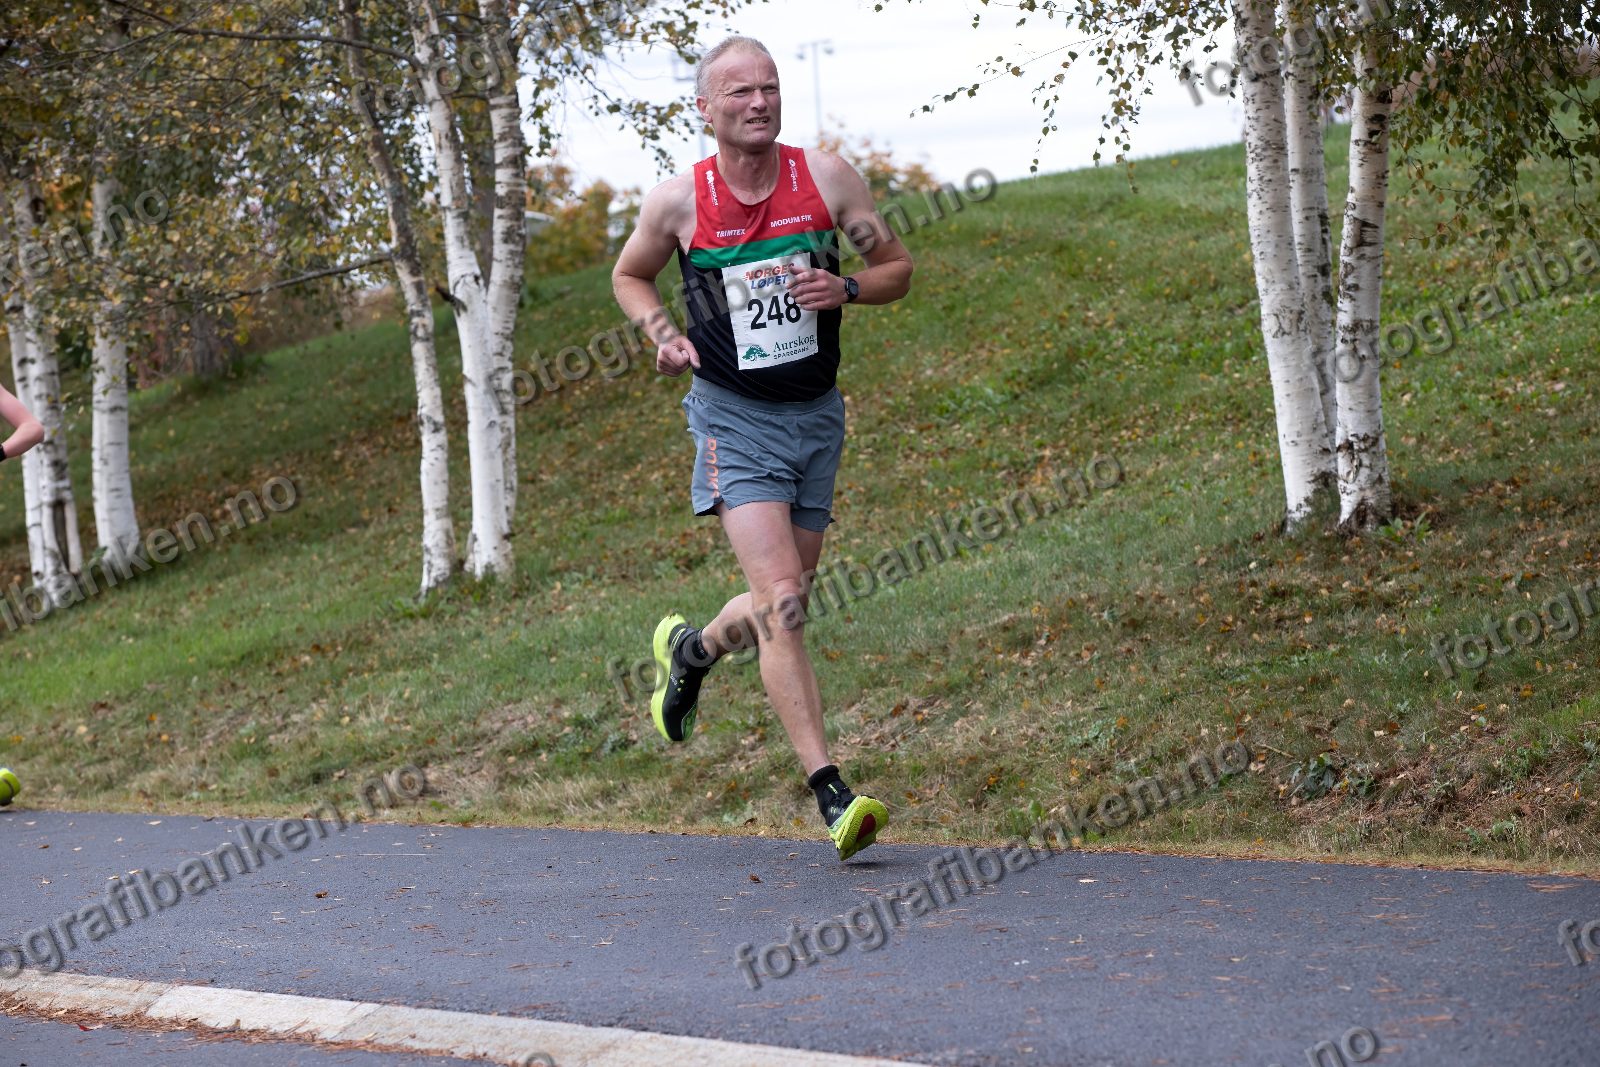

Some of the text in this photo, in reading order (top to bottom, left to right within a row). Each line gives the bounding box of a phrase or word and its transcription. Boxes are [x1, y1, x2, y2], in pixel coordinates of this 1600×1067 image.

[770, 214, 812, 228] MODUM FIK
[716, 228, 746, 238] TRIMTEX
[751, 274, 788, 290] LØPET
[747, 292, 801, 330] 248
[773, 334, 817, 353] Aurskog
